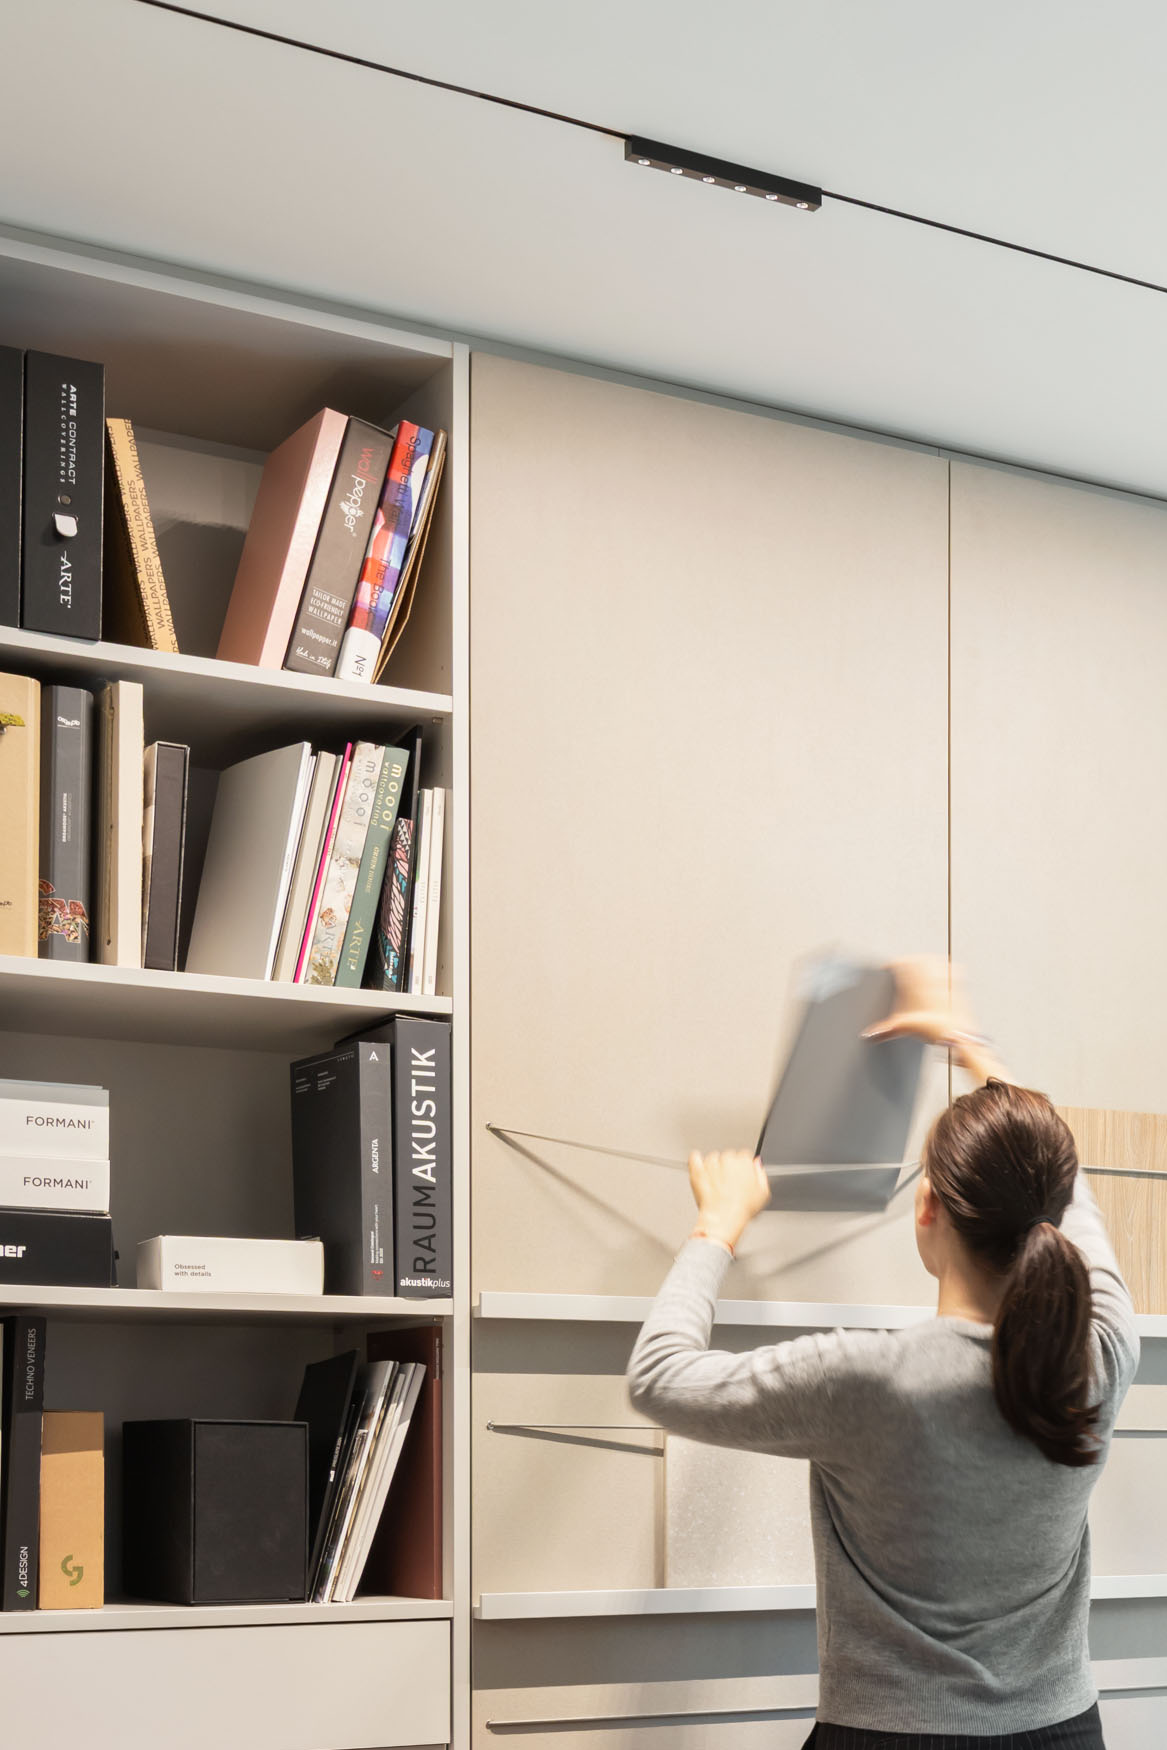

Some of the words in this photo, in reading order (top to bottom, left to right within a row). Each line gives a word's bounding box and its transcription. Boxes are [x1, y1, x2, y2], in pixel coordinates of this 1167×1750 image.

[68, 384, 78, 417] ARTE
[68, 420, 77, 486] CONTRACT
[140, 488, 159, 557] WALLPAPERS
[128, 480, 149, 552] WALLPAPERS
[144, 557, 165, 629] WALLPAPERS
[308, 606, 342, 625] WALLPAPER
[381, 763, 402, 832] mooi
[26, 1116, 91, 1130] FORMANI
[23, 1176, 90, 1190] FORMANI
[174, 1263, 206, 1271] Obsessed
[400, 1276, 451, 1289] akustikplus
[27, 1328, 37, 1363] VENEERS
[25, 1364, 36, 1400] TECHNO
[20, 1546, 29, 1587] 4DESIGN
